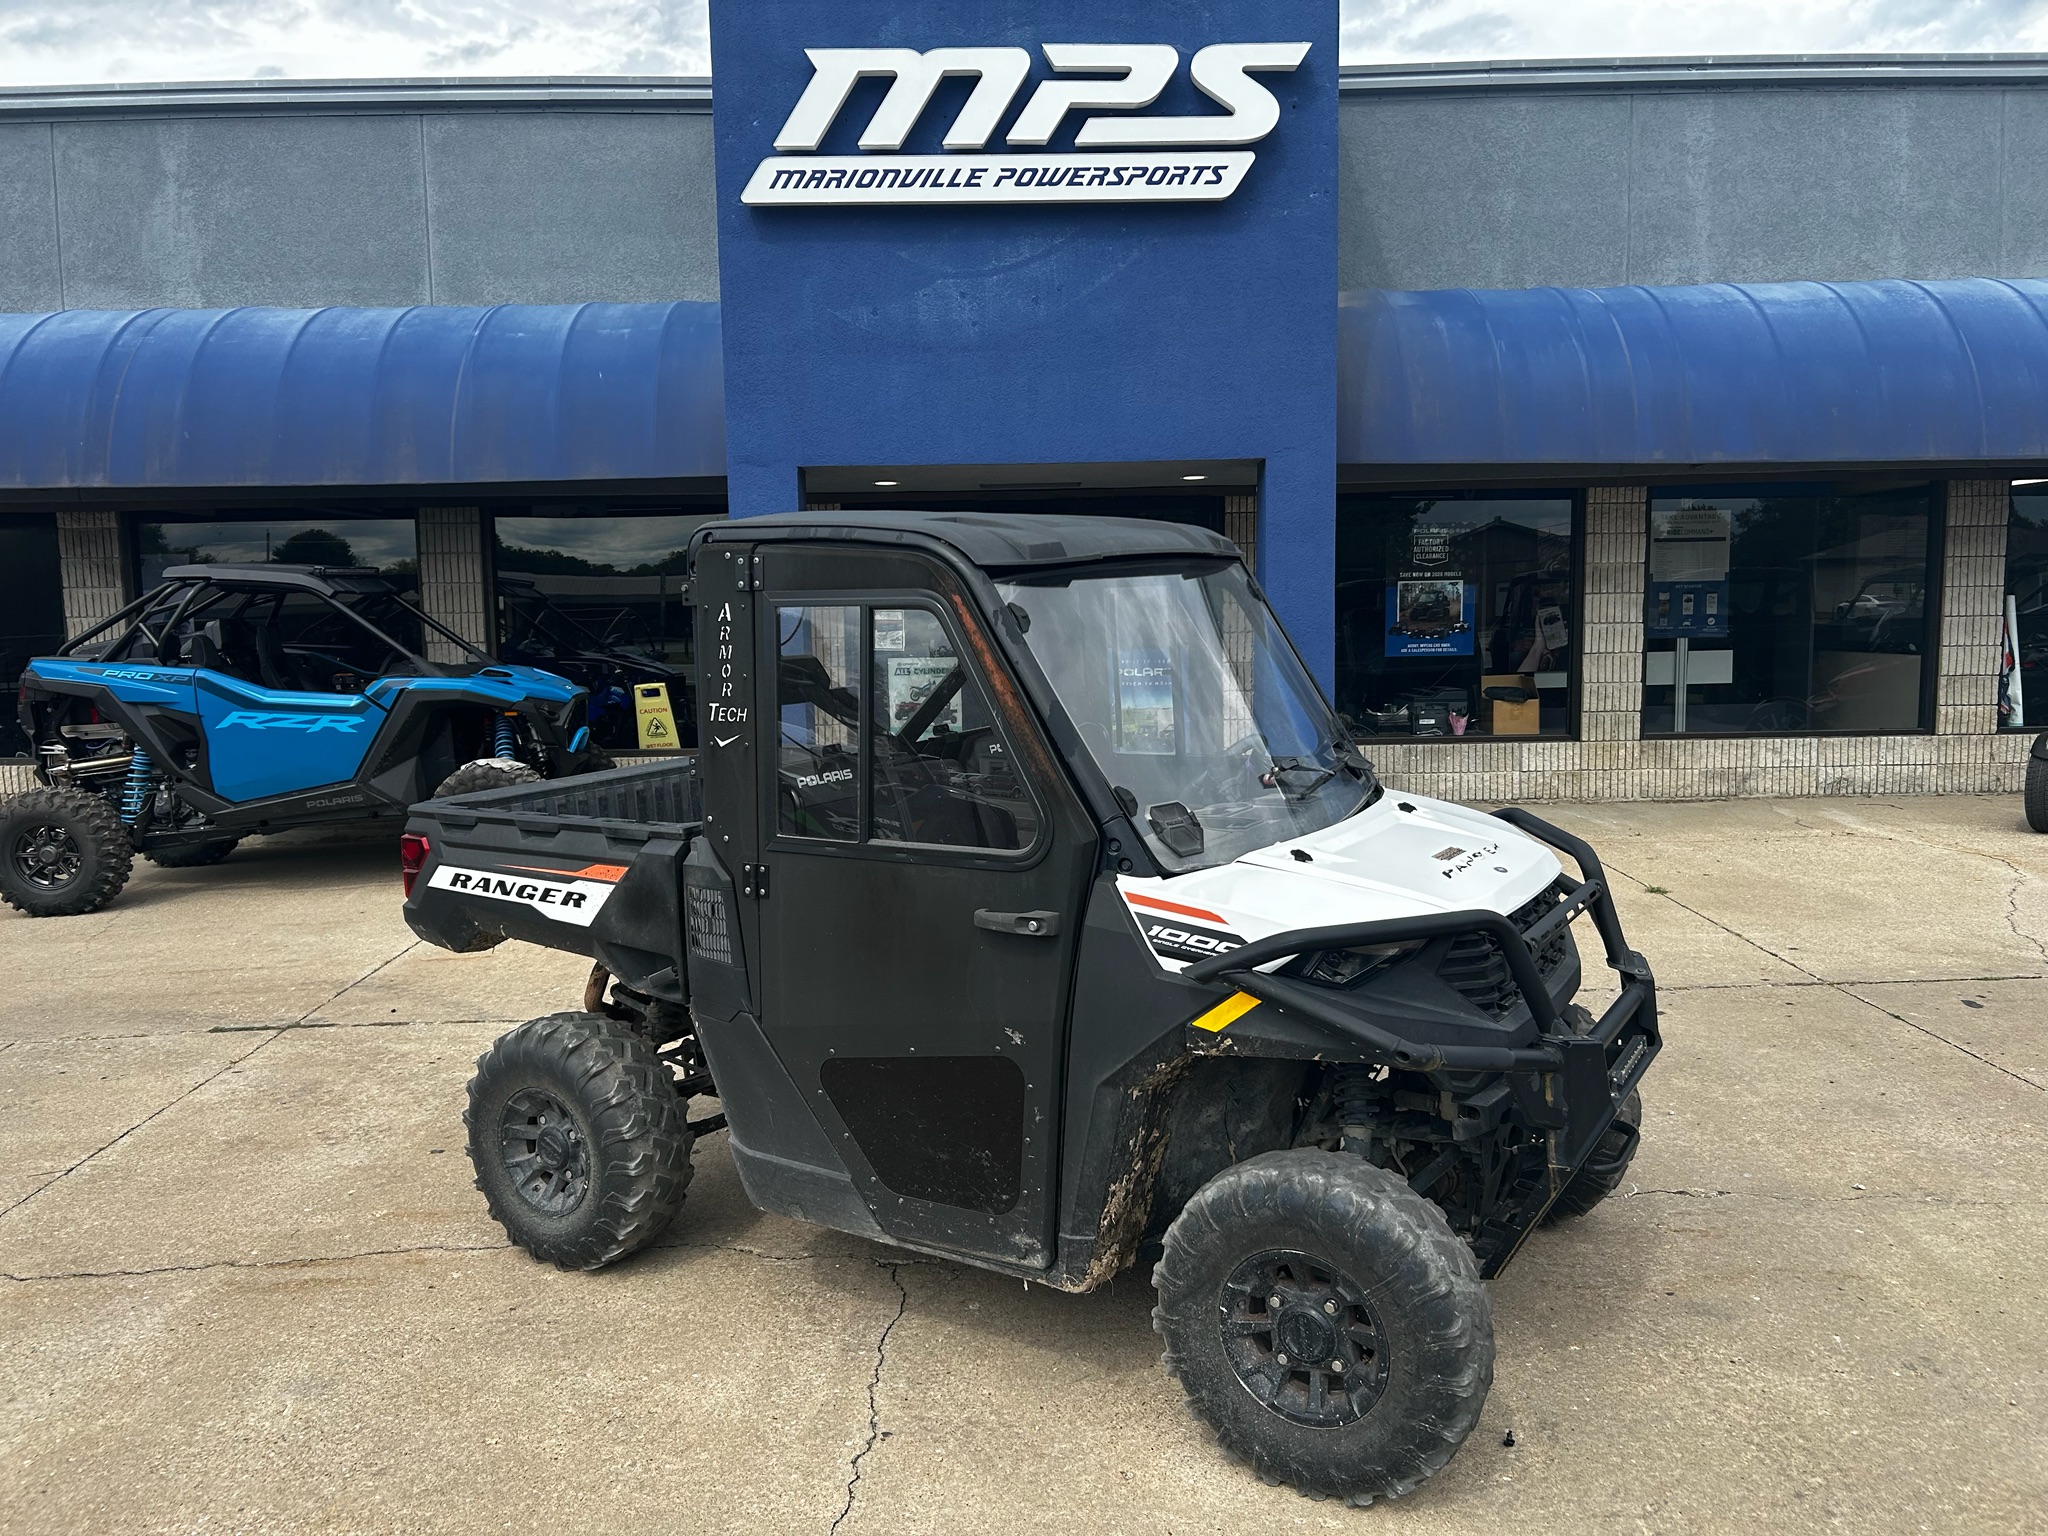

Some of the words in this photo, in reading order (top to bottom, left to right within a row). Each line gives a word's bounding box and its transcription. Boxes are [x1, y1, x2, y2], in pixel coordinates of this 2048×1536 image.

[773, 42, 1312, 150] MPS
[768, 167, 989, 190] MARIONVILLE
[992, 164, 1229, 188] POWERSPORTS
[717, 602, 733, 697] ARMOR
[101, 669, 154, 681] PRO
[152, 673, 191, 683] XP
[1118, 667, 1172, 677] OLAR
[639, 706, 668, 715] CAUTION
[215, 711, 365, 733] RZR
[797, 768, 854, 789] POLARIS
[306, 794, 364, 809] POLARIS
[449, 872, 588, 909] RANGER
[1180, 945, 1219, 957] OVERHEA
